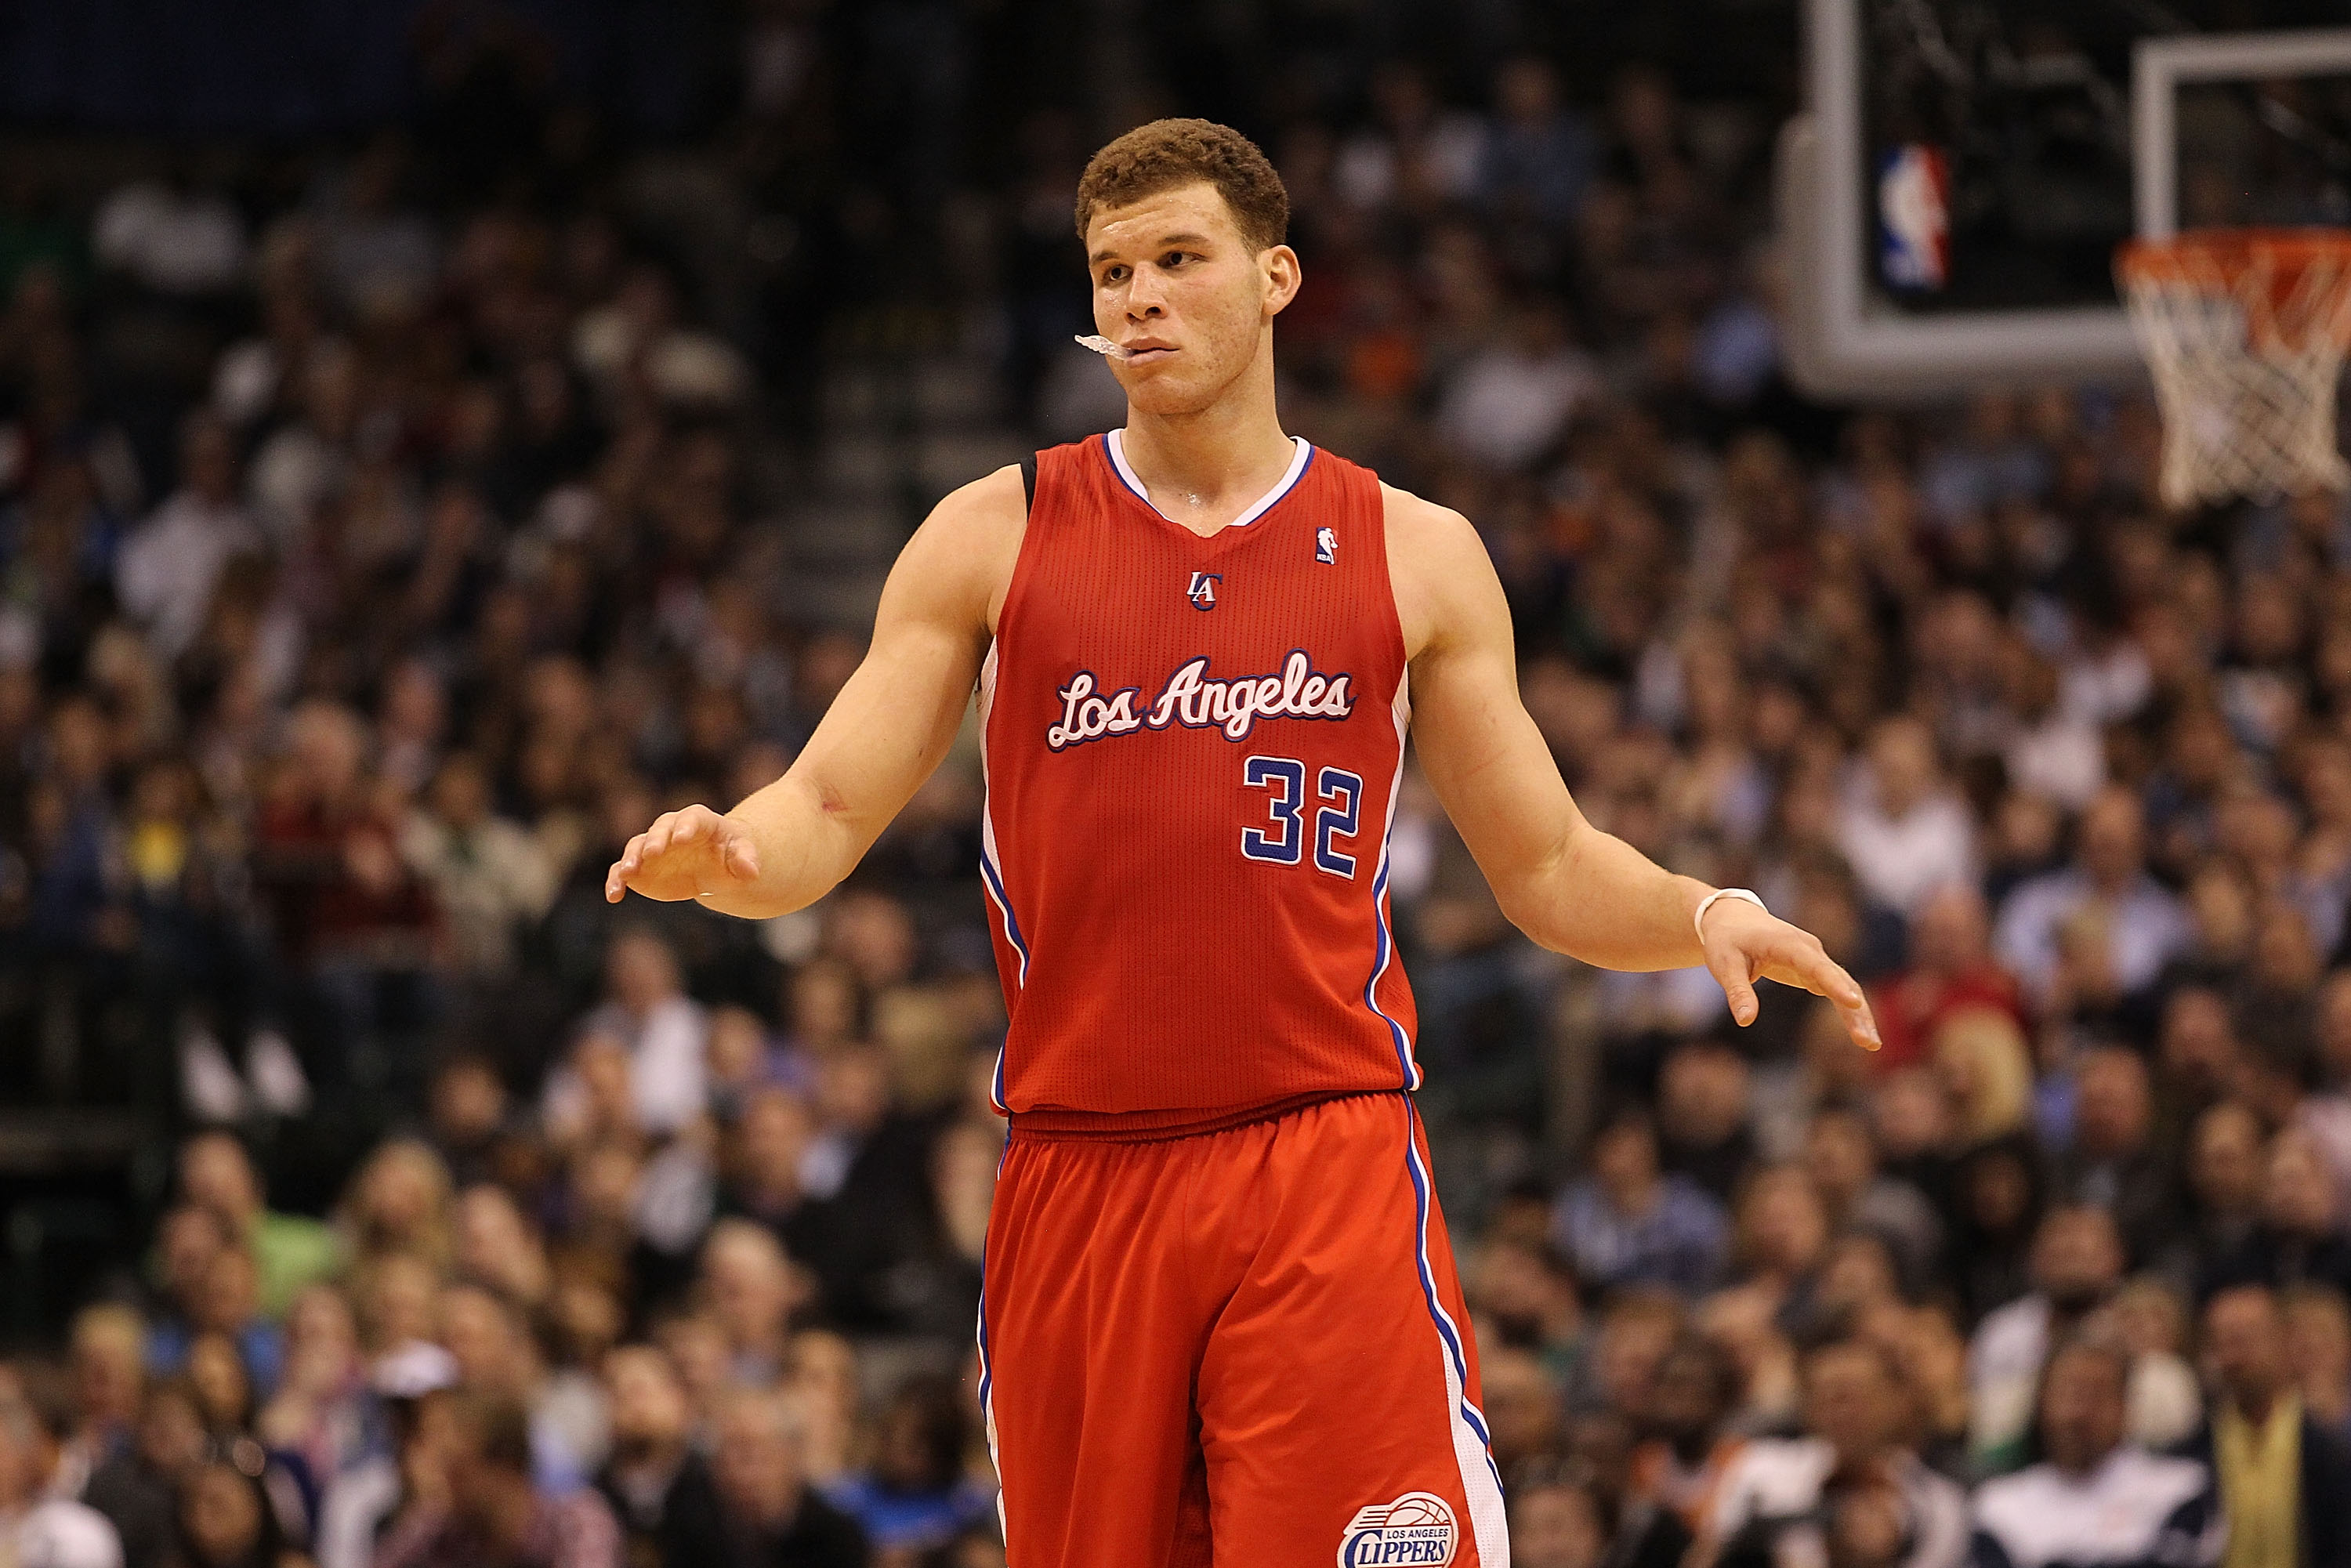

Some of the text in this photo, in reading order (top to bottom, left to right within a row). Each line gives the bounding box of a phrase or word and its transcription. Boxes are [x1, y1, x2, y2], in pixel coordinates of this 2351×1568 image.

[1317, 553, 1331, 562] NBA
[1047, 650, 1354, 750] Los Angeles
[1241, 755, 1364, 880] 32
[1344, 1530, 1447, 1568] CLIPPERS
[1387, 1528, 1449, 1539] LOS ANGELES
